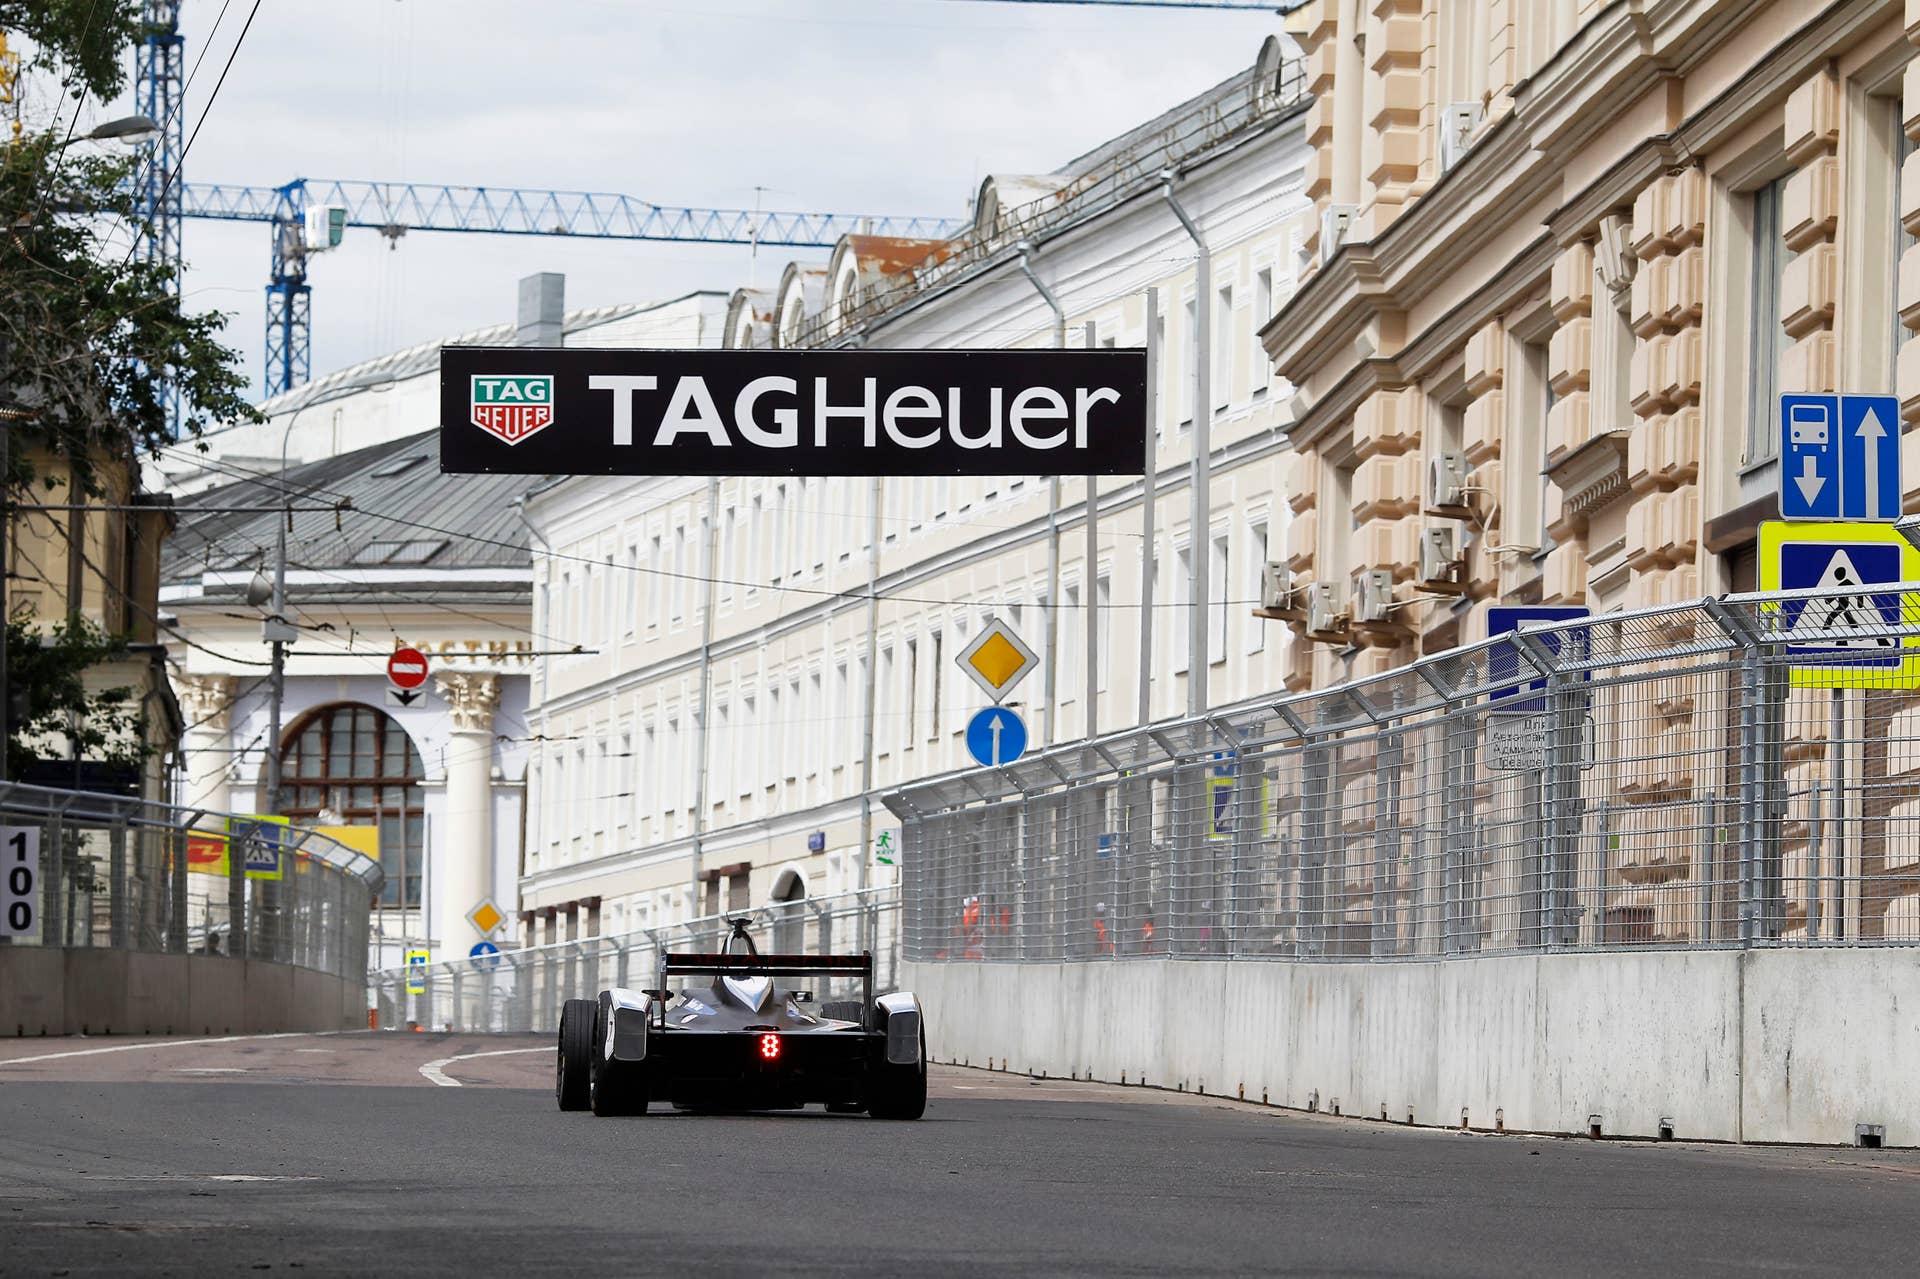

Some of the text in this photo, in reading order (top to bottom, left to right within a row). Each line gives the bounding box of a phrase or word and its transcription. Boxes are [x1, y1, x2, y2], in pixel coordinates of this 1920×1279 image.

[478, 380, 546, 401] TAG
[476, 407, 548, 439] HEUER
[8, 831, 33, 931] 100
